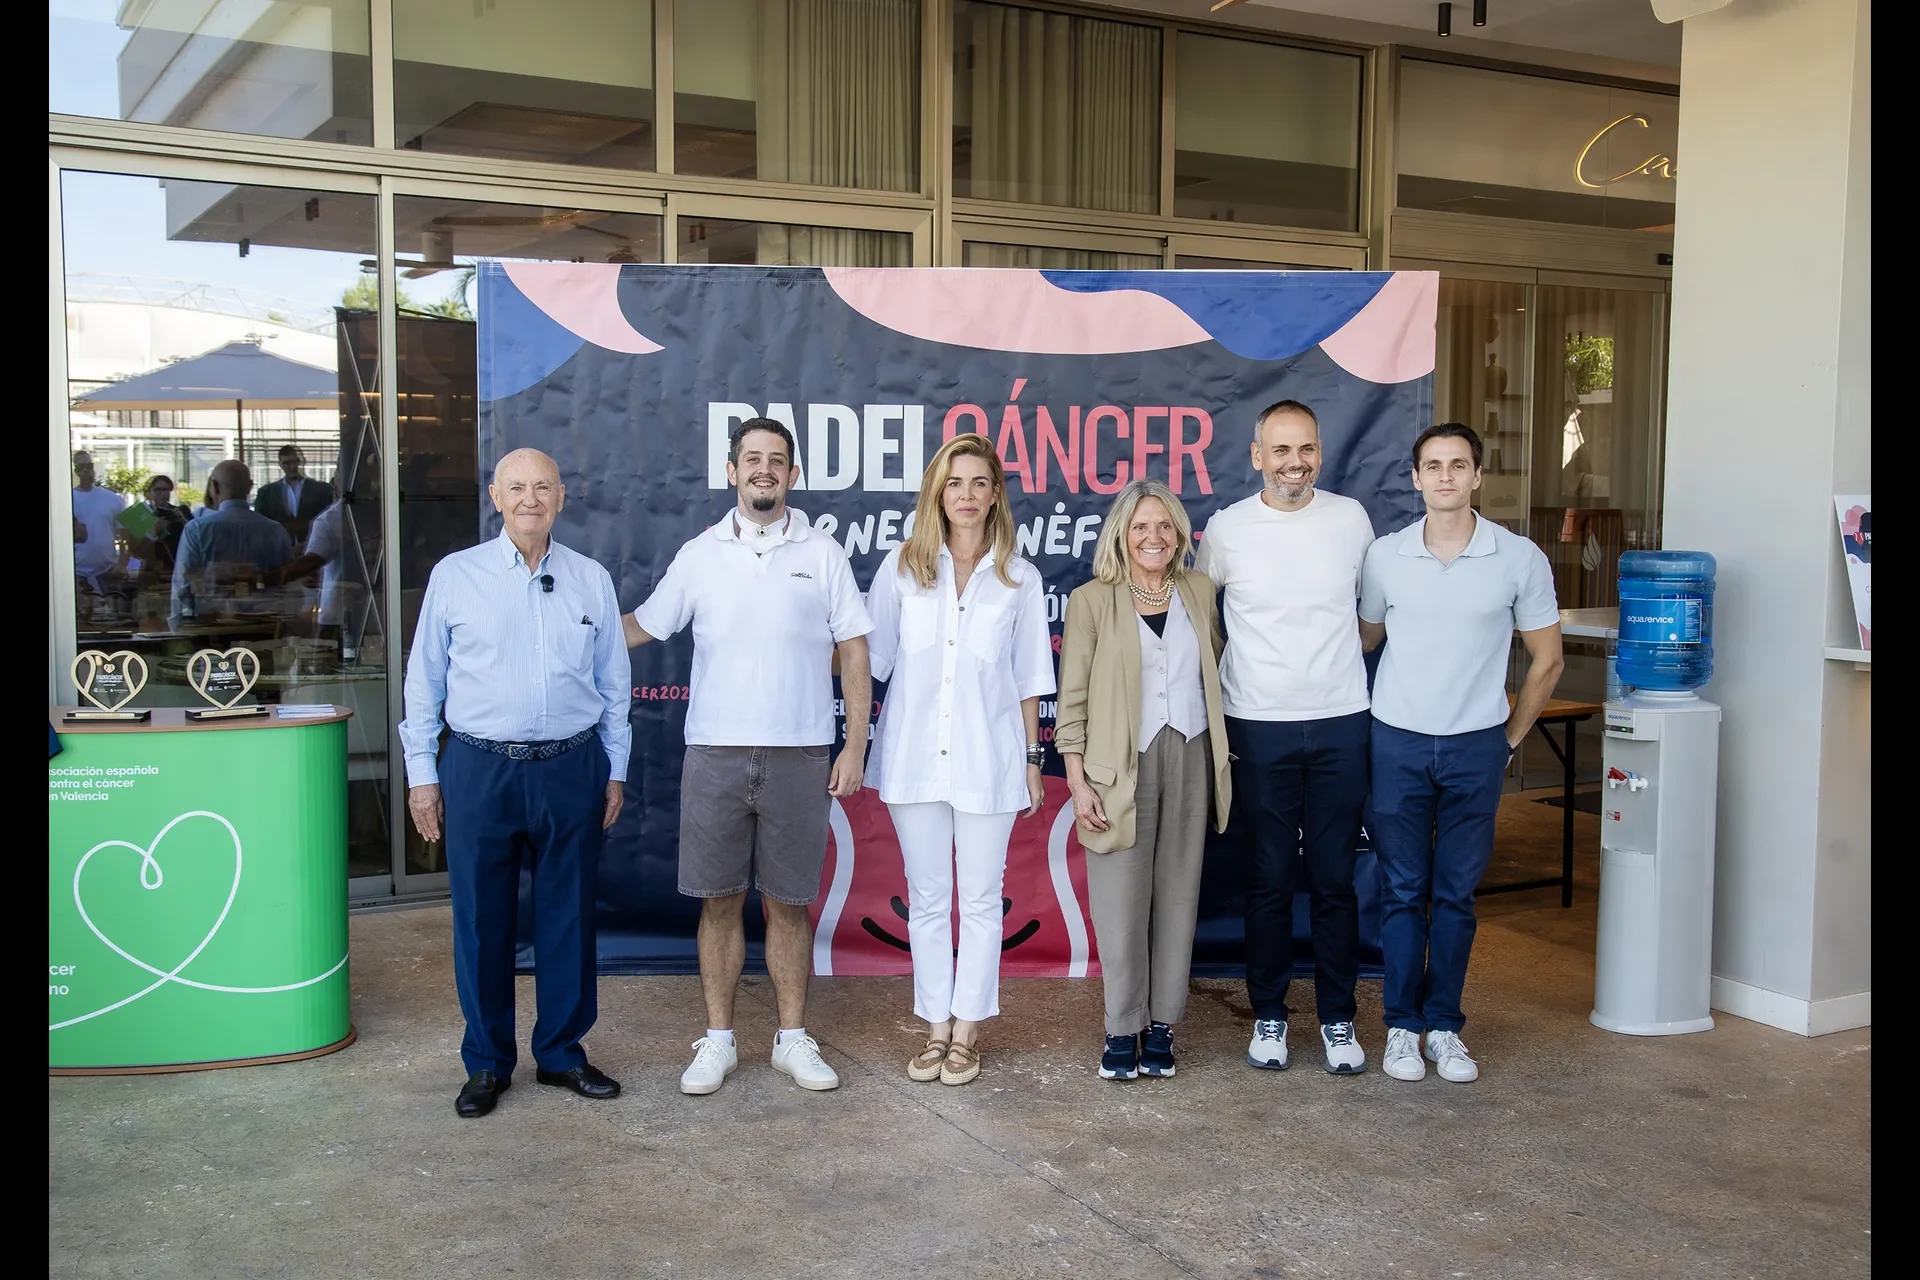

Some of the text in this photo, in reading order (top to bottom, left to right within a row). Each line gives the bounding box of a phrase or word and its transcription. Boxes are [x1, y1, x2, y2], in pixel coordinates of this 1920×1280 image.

[1627, 615, 1674, 625] aquaservice
[49, 765, 159, 777] sociación española
[49, 778, 135, 788] ontra el cáncer
[60, 791, 109, 801] Valencia
